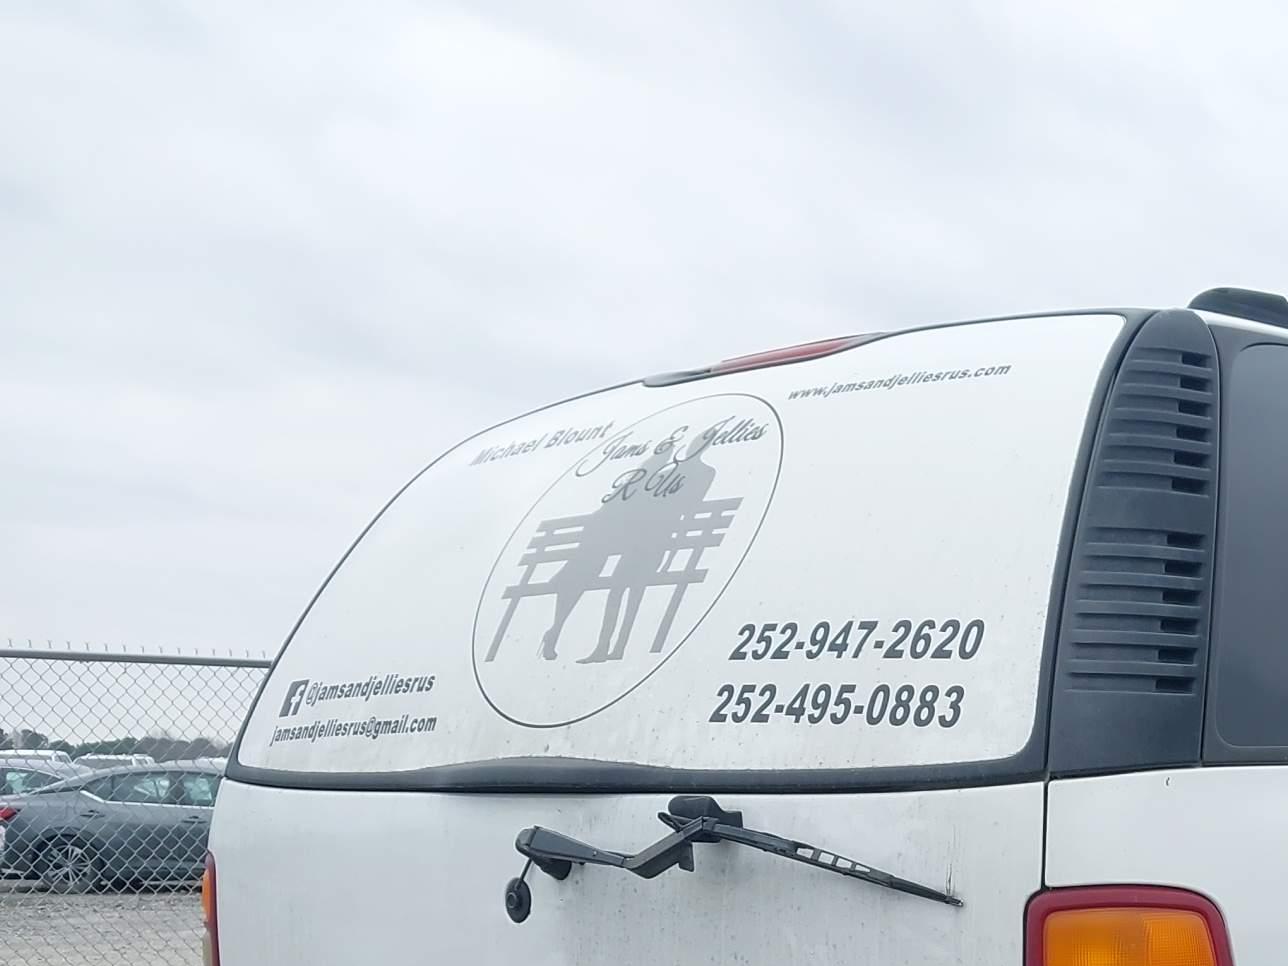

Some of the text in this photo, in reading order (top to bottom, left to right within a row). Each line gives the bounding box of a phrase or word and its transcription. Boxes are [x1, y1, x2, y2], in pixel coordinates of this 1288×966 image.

[787, 363, 1012, 401] www.jamsandjelliesrus.com
[467, 418, 616, 467] Michael Blount
[575, 415, 770, 478] Jams & Jellies
[601, 461, 686, 505] R Us
[728, 618, 985, 662] 252-947-2620
[306, 673, 436, 707] @jamsandjelliesrus
[708, 682, 966, 729] 252-495-0883
[269, 714, 438, 747] jamsandjelliesrus@gmail.com
